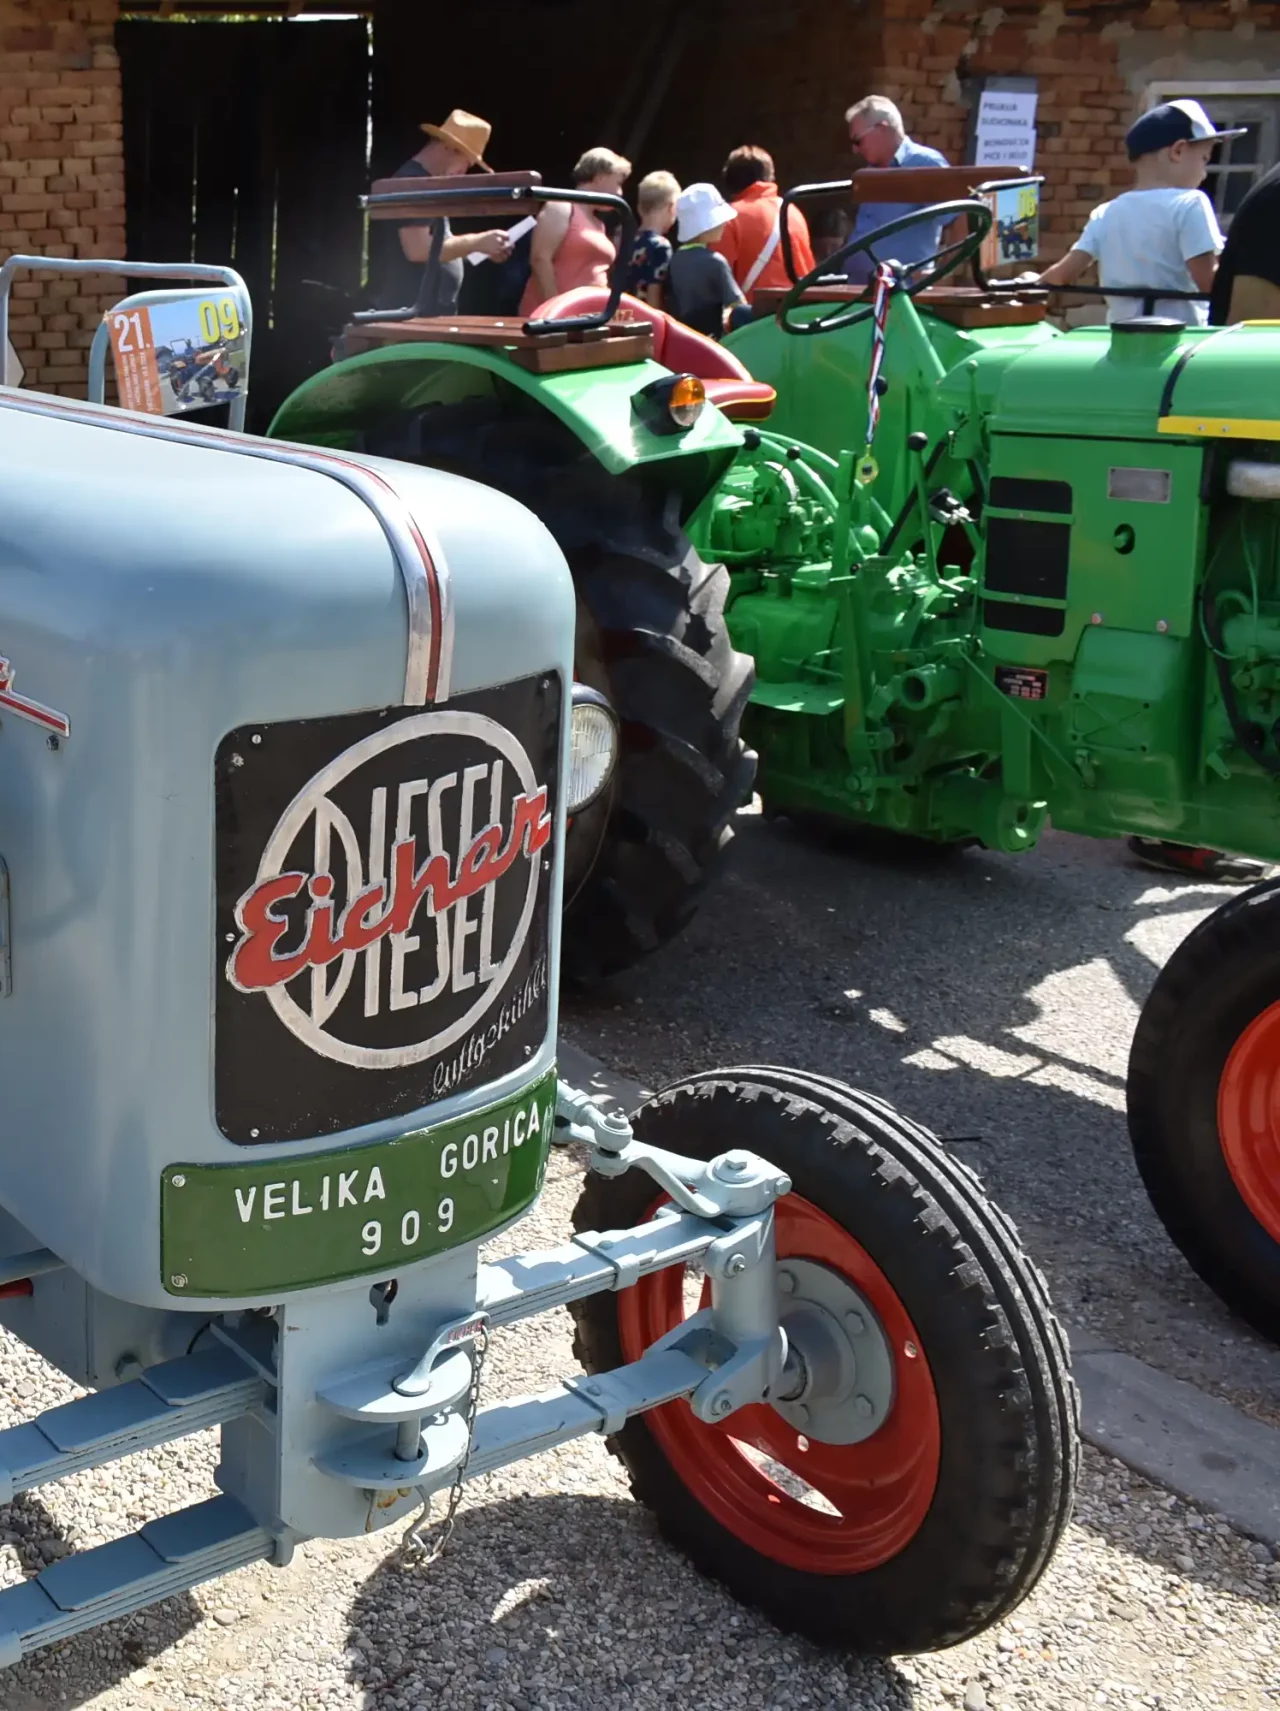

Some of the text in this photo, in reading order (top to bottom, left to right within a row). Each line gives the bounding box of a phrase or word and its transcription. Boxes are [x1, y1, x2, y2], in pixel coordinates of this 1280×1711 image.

[114, 312, 151, 353] 21.
[198, 298, 241, 345] 09
[225, 785, 551, 994] Eicher
[310, 757, 503, 1030] DIESEL
[234, 1101, 541, 1223] VELIKA GORICA
